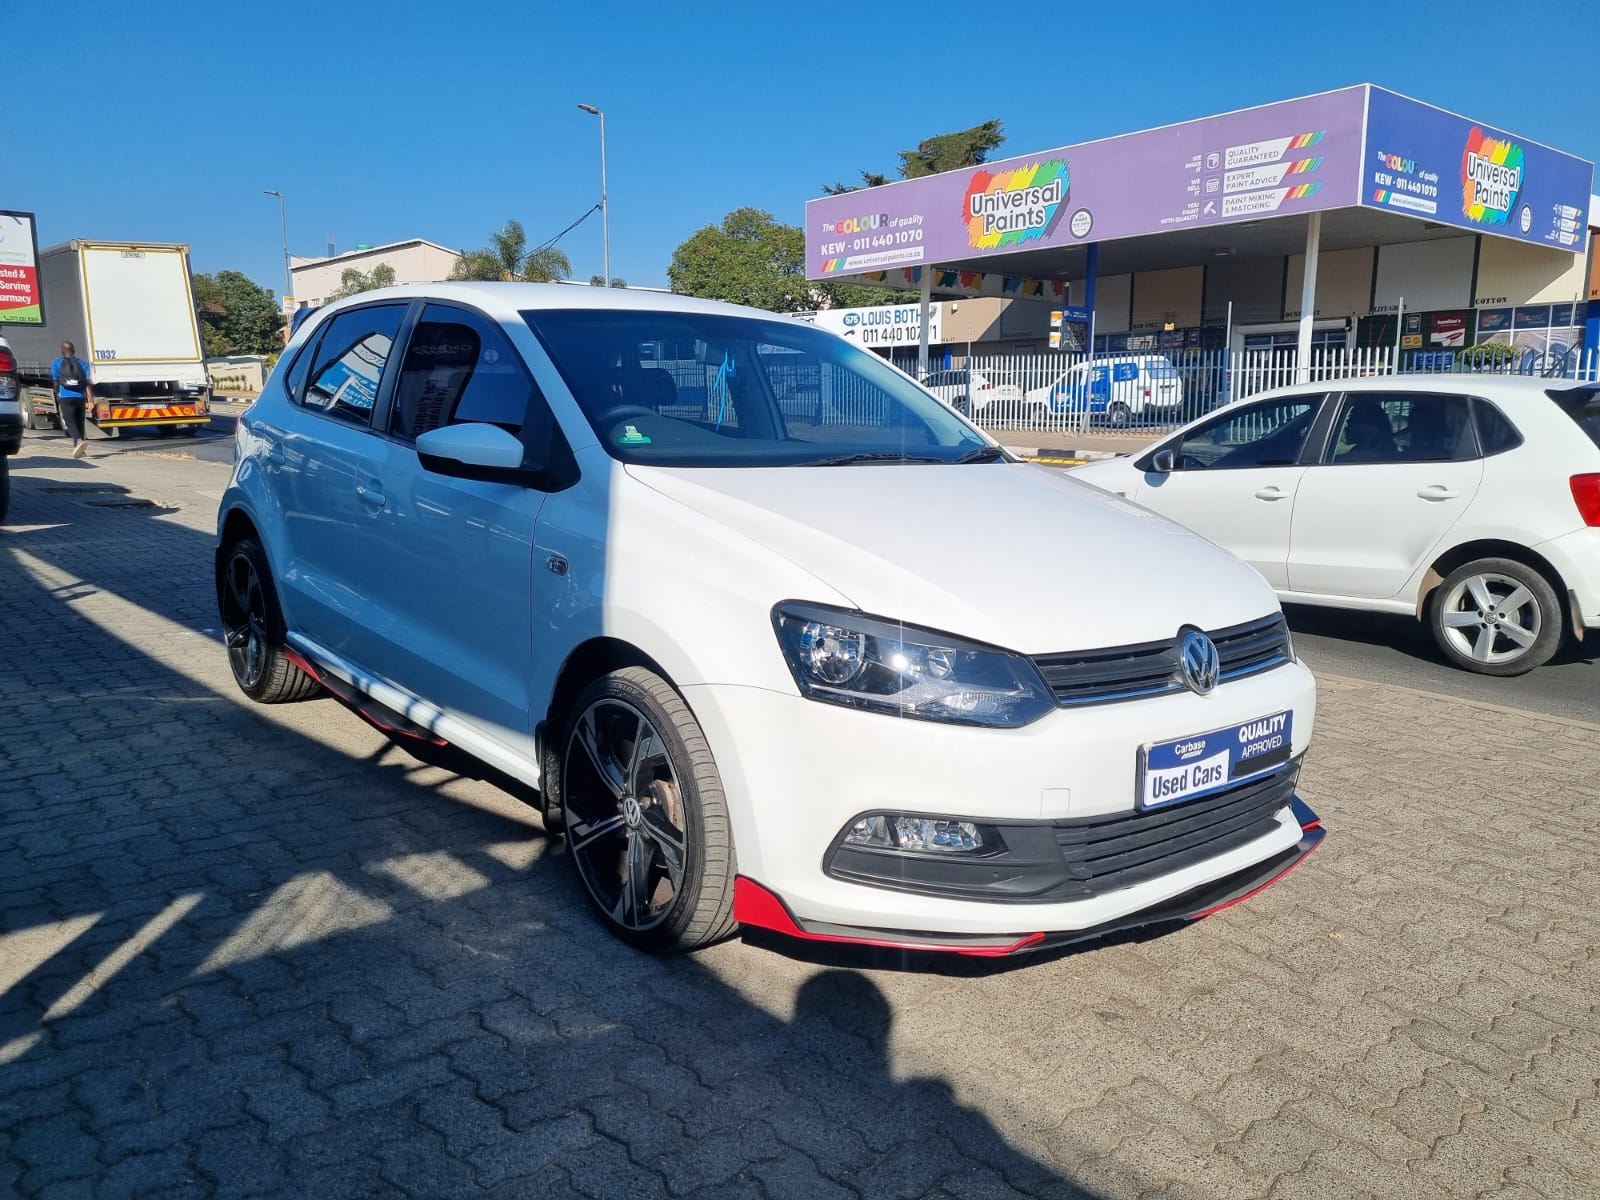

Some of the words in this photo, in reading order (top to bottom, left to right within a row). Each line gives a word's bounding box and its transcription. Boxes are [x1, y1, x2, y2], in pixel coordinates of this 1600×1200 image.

[1227, 150, 1279, 166] GUARANTEED
[1228, 146, 1259, 158] QUALITY
[1377, 150, 1386, 162] The
[1385, 153, 1418, 175] COLOUR
[1419, 170, 1425, 178] of
[1424, 172, 1439, 184] quality
[1468, 153, 1519, 190] Universal
[1226, 171, 1256, 182] EXPERT
[1226, 180, 1248, 189] PAINT
[1250, 175, 1278, 185] ADVICE
[1375, 171, 1392, 186] KEW
[1396, 177, 1407, 190] 011
[1408, 180, 1421, 194] 440
[1421, 183, 1437, 197] 1070
[971, 180, 1062, 215] Universal
[1225, 196, 1247, 206] PAINT
[1249, 192, 1276, 202] MIXING
[1474, 180, 1509, 209] Paints
[1231, 201, 1270, 212] MATCHING
[822, 223, 835, 233] The
[835, 213, 889, 236] COLOUR
[889, 217, 898, 228] of
[898, 214, 925, 228] quality
[984, 206, 1045, 235] Paints
[1175, 214, 1199, 223] QUALITY
[821, 241, 846, 256] KEW
[853, 237, 870, 250] 011
[872, 233, 893, 248] 440
[895, 229, 923, 244] 1070
[19, 269, 27, 279] &
[0, 281, 31, 293] Serving
[1475, 296, 1507, 305] COTTON
[861, 310, 891, 326] LOUIS
[894, 308, 922, 324] BOTH
[863, 328, 878, 343] 011
[881, 328, 902, 342] 440
[95, 350, 117, 360] T032
[1238, 714, 1287, 743] QUALITY
[1174, 740, 1206, 755] Carbase
[1241, 734, 1283, 759] APPROVED
[1152, 767, 1188, 799] Used
[1191, 764, 1222, 788] Cars
